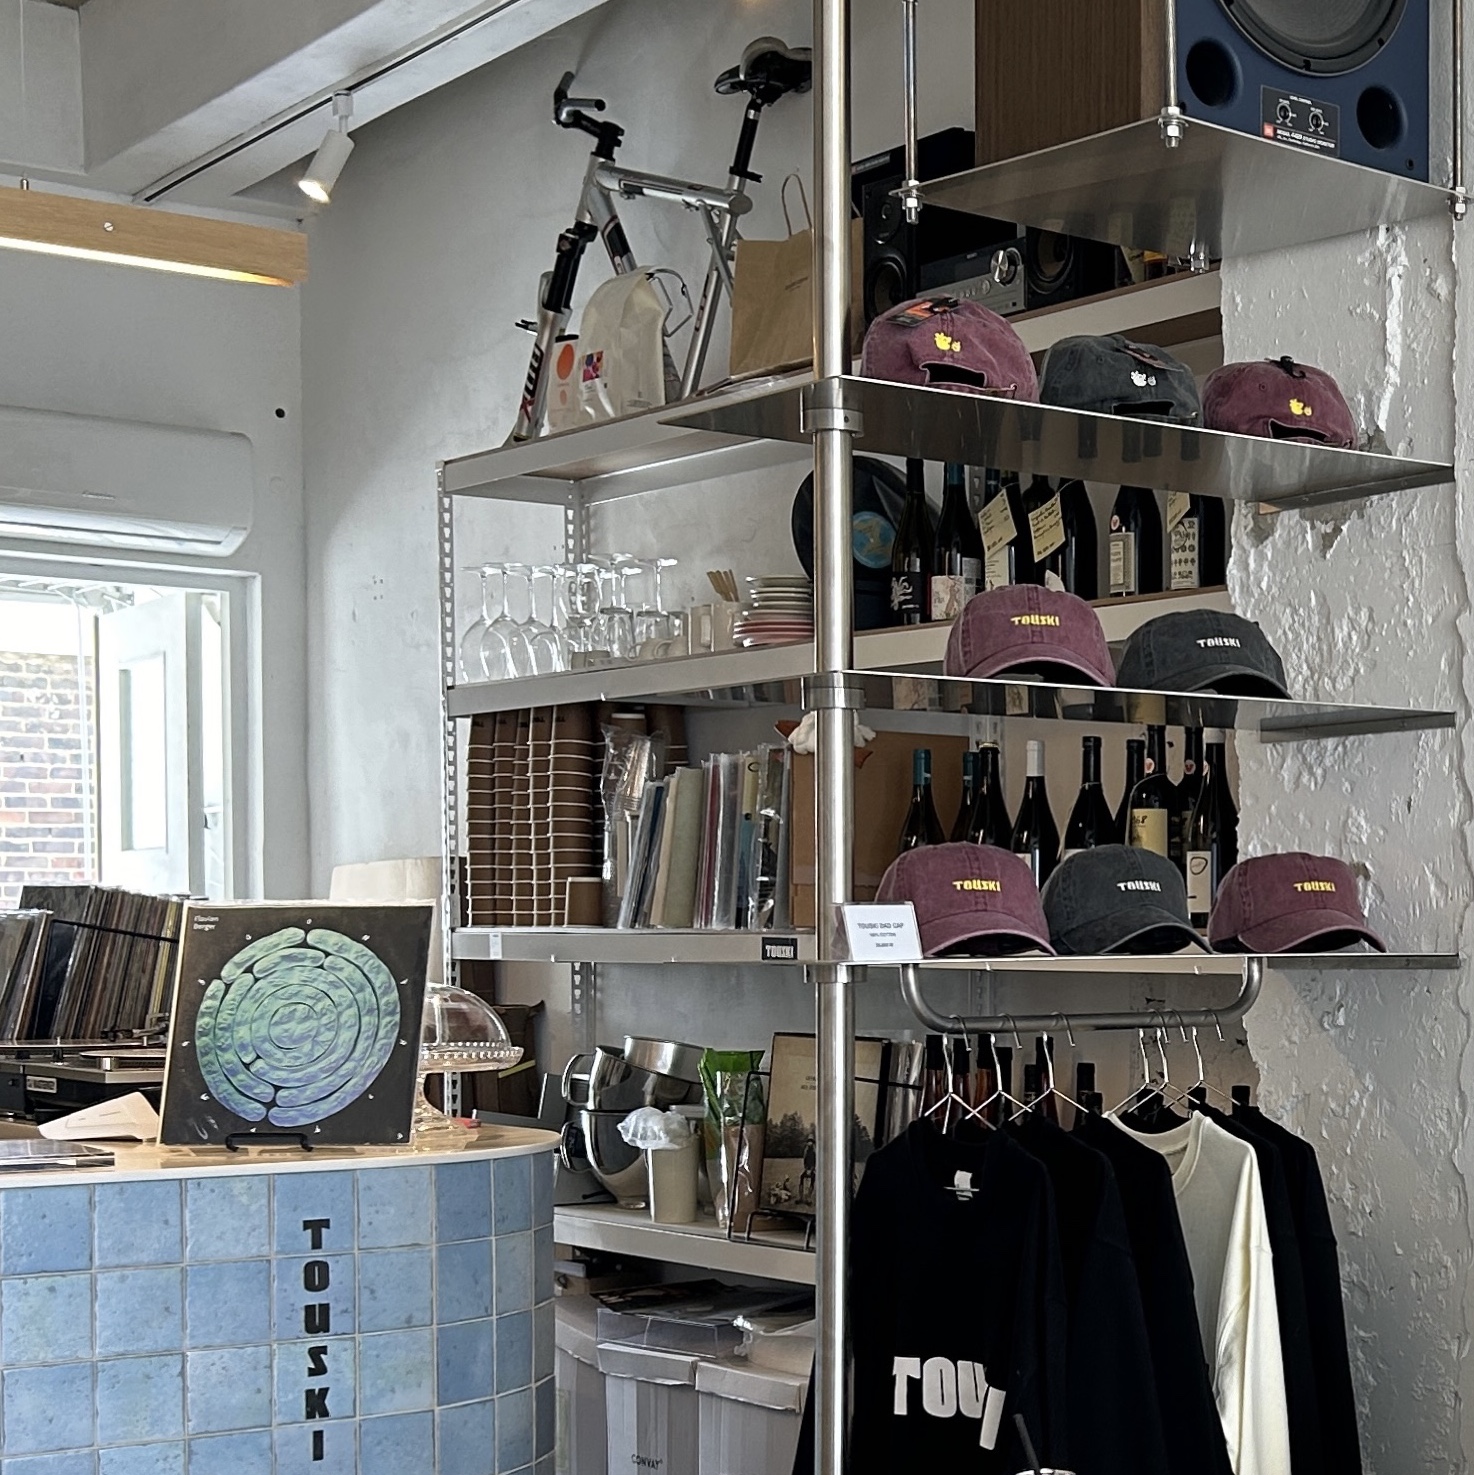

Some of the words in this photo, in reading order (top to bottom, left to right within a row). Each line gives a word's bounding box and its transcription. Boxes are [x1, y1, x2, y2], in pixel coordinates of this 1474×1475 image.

[1010, 614, 1060, 627] TOUSKI
[1196, 636, 1241, 649] TOUSKI
[952, 879, 1001, 892] TOUSKI
[1117, 880, 1162, 893] TOUSKI
[1294, 880, 1336, 893] TOUSKI
[766, 945, 793, 958] TOUSKI
[302, 1218, 330, 1461] TOUSKI
